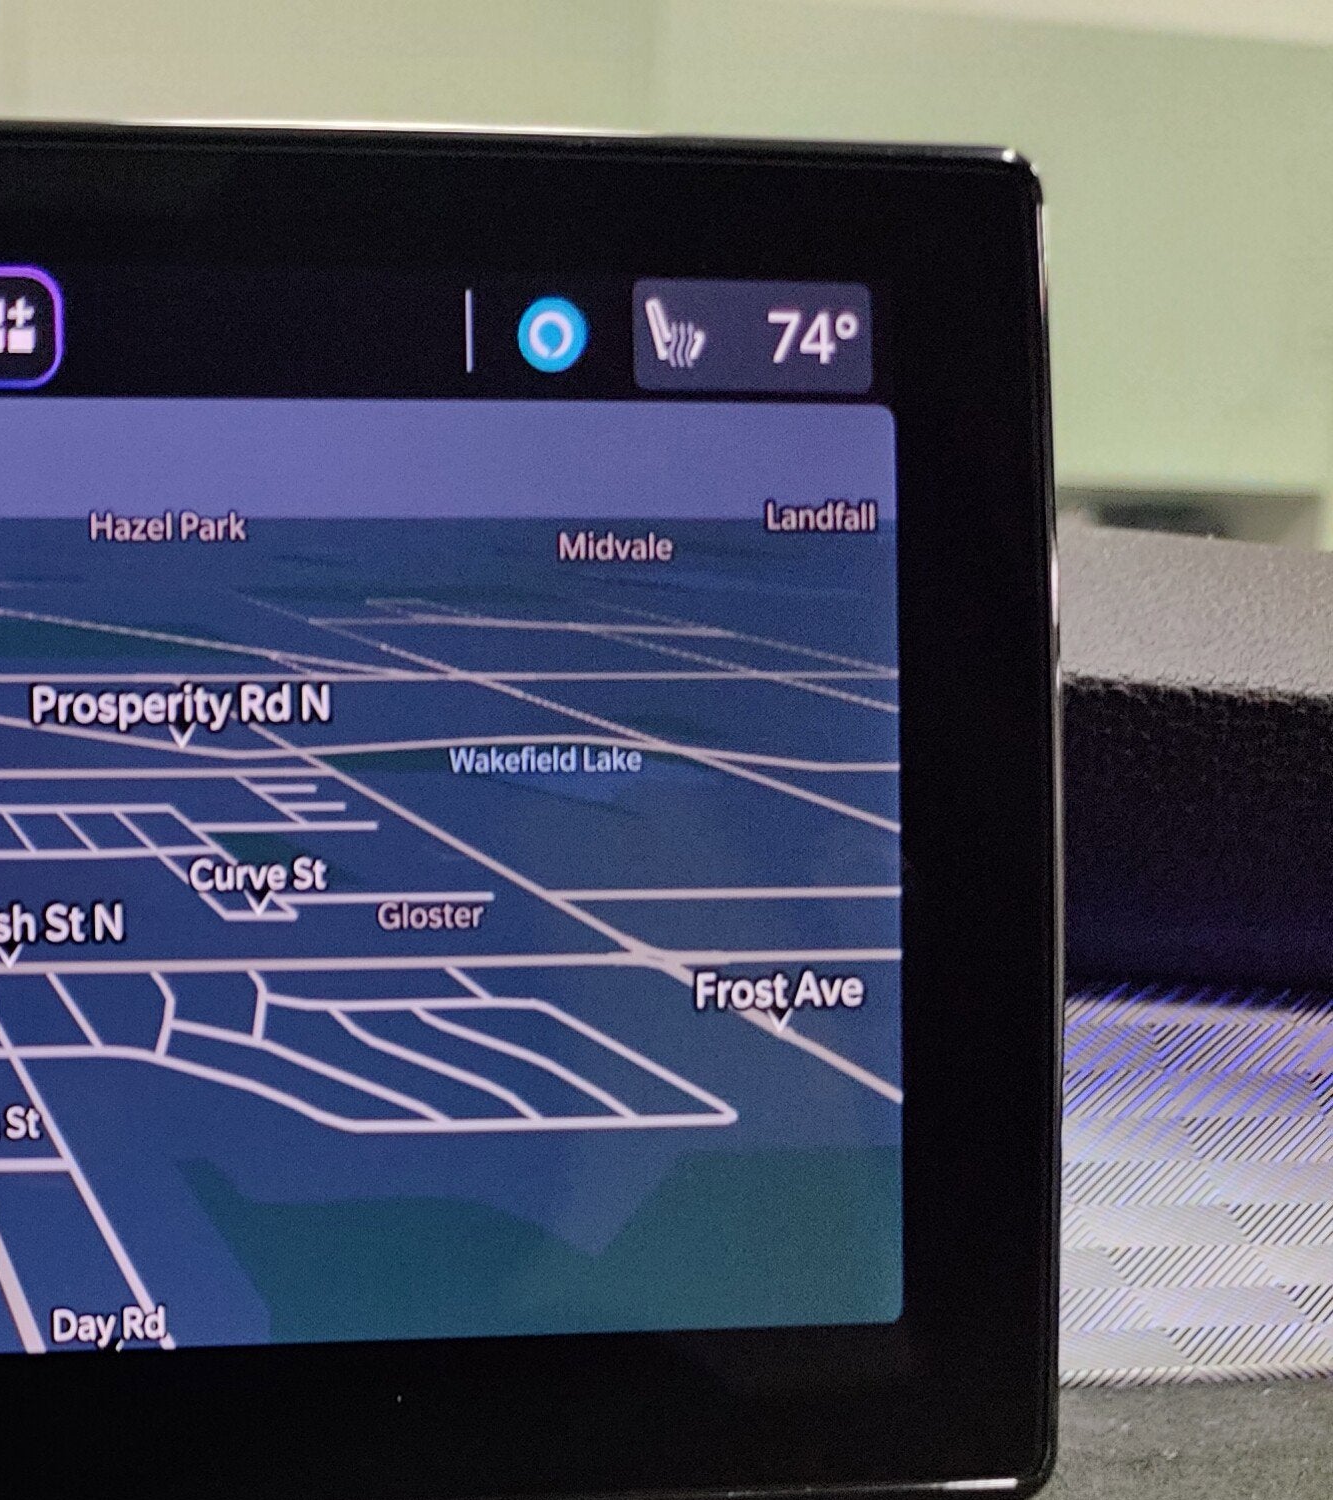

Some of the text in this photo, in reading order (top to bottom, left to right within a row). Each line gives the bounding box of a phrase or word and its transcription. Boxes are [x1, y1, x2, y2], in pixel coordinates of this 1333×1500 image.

[767, 309, 860, 365] 74°
[89, 512, 247, 542] Hazel Park
[765, 501, 877, 532] Landfall
[558, 531, 674, 562] Midvale
[32, 683, 332, 730] Prosperity Rd N
[449, 746, 643, 775] Wakefield Lake
[189, 858, 328, 892] Curve St
[44, 904, 86, 942] St
[94, 904, 125, 942] N
[377, 901, 485, 932] Gloster
[694, 971, 864, 1010] Frost Ave
[5, 1108, 42, 1142] St
[52, 1307, 167, 1349] Day Rd
